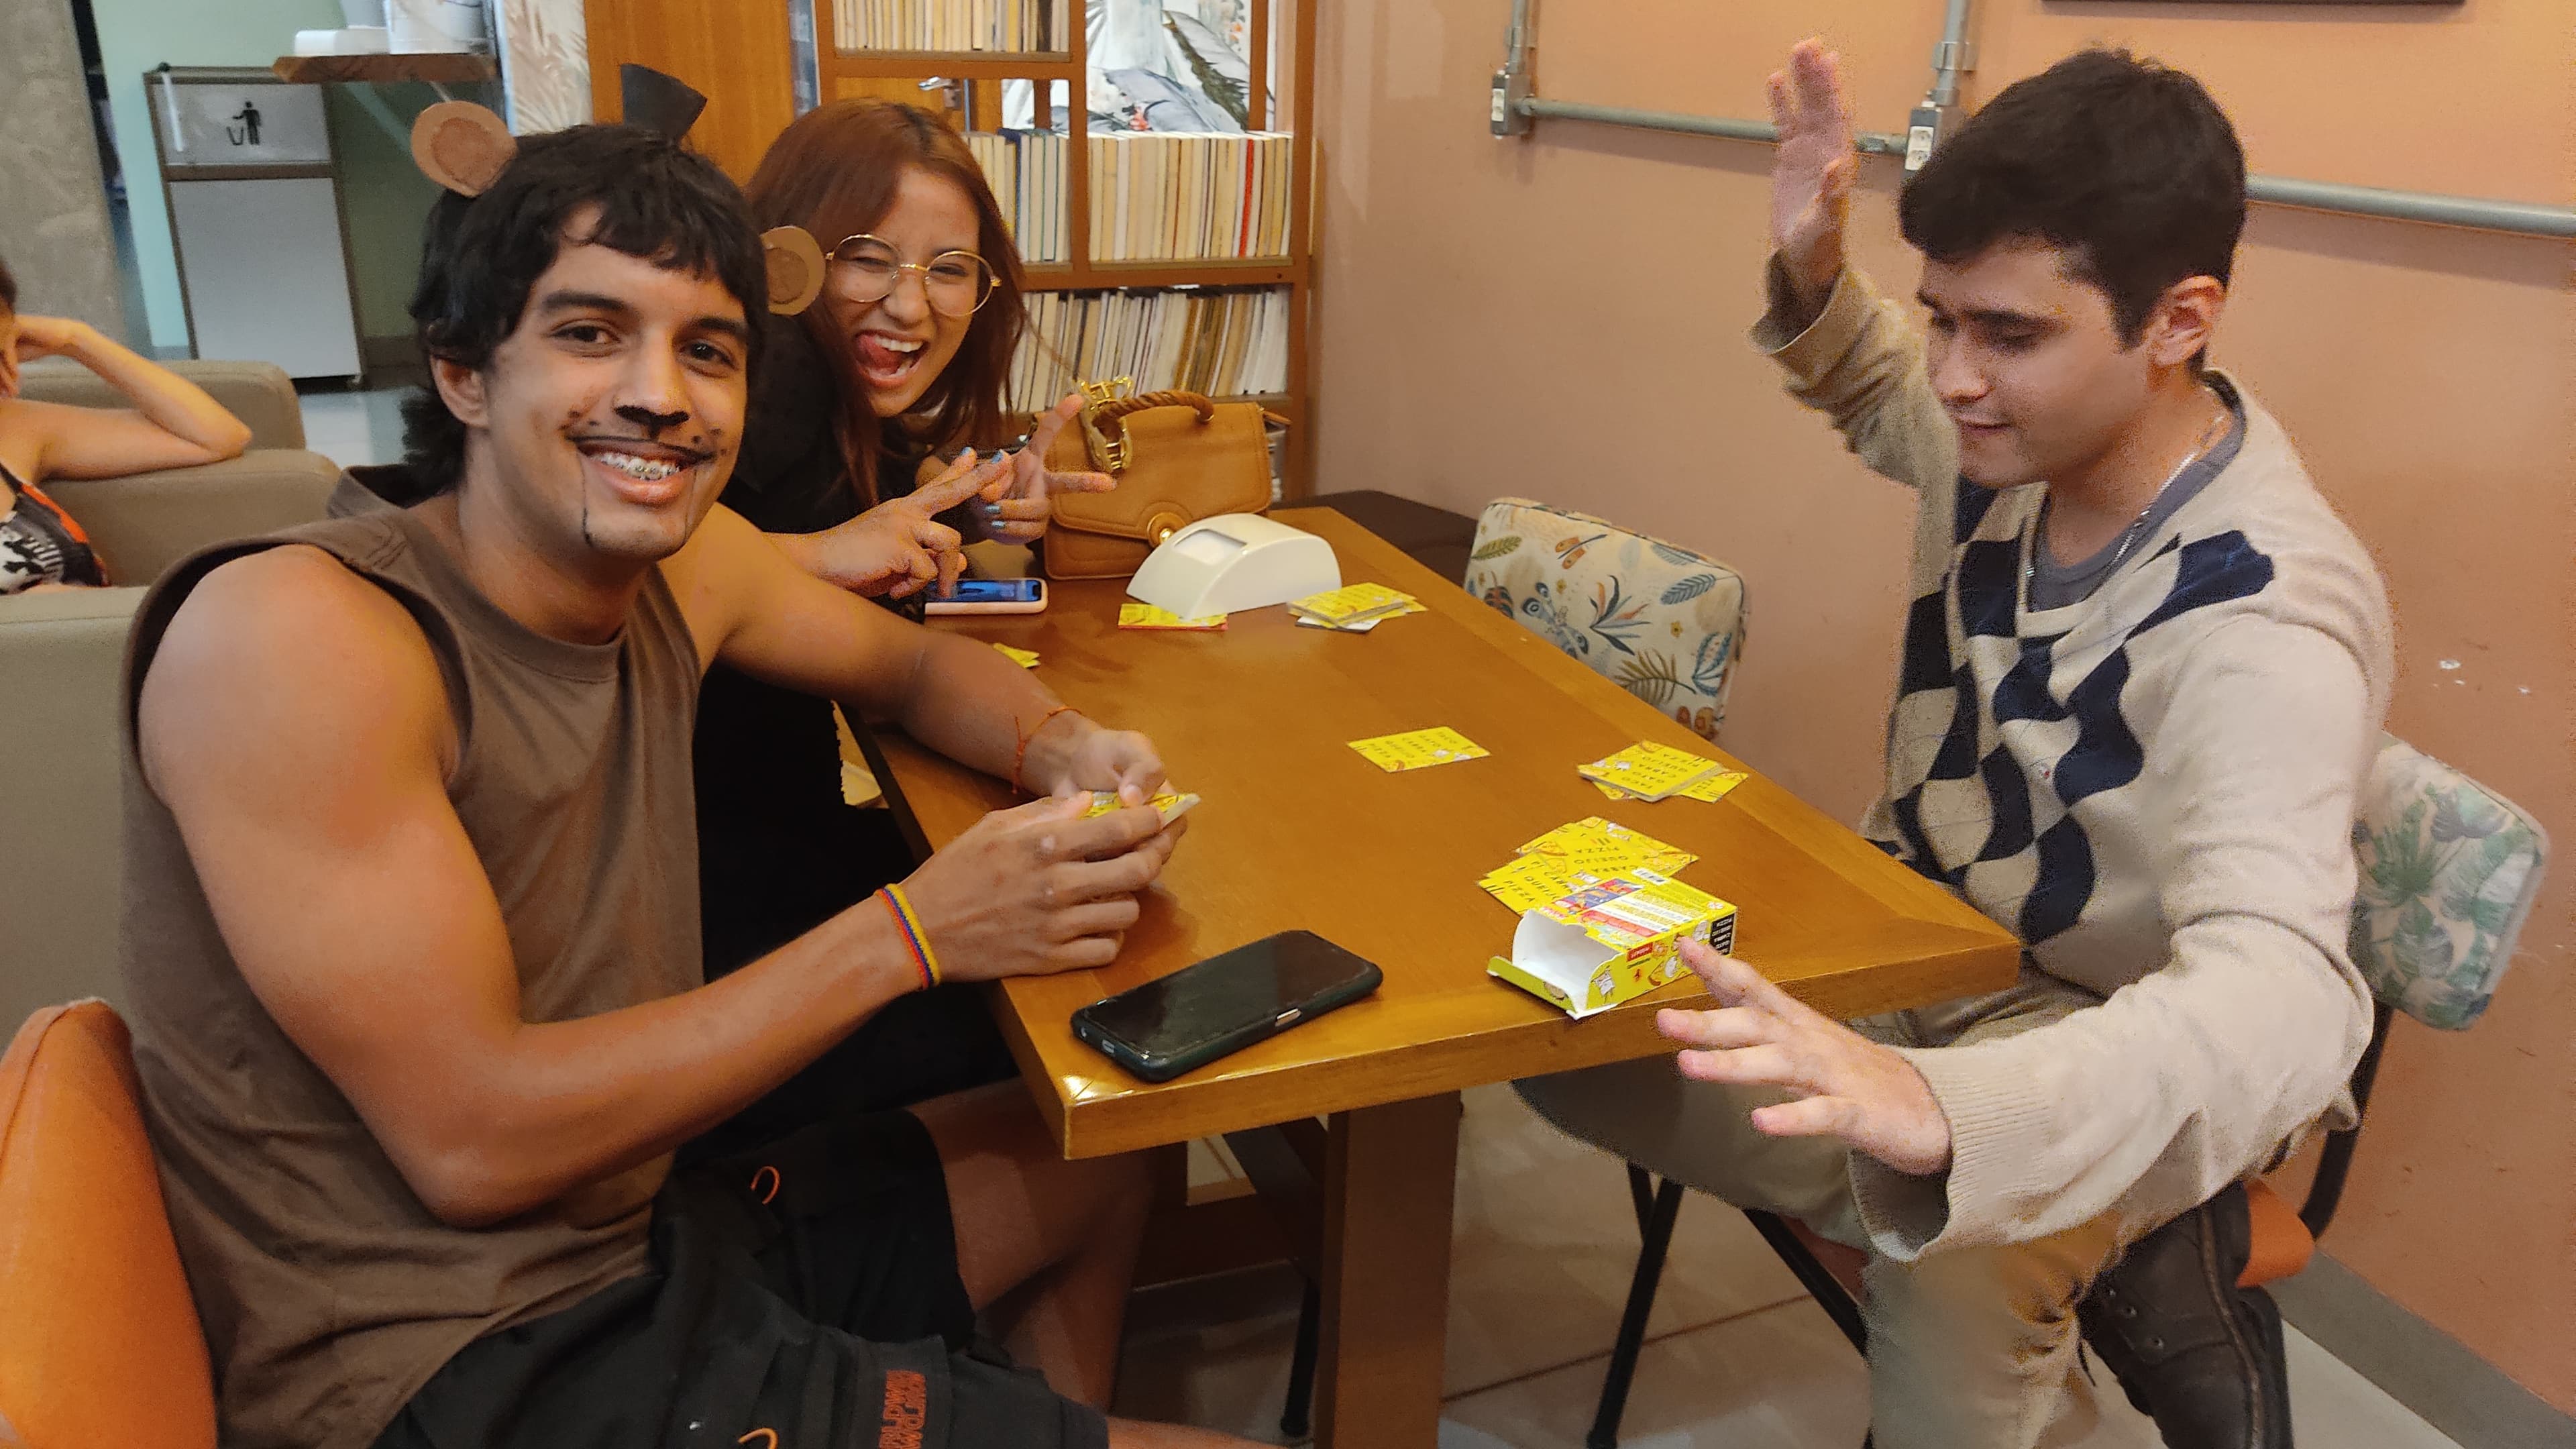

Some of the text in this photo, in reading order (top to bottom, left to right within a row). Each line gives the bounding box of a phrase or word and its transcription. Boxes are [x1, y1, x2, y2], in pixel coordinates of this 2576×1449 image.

[1642, 756, 1688, 772] QUEIJO
[1663, 753, 1700, 767] PIZZA
[1632, 771, 1665, 784] GATO
[1639, 763, 1676, 778] CABRA
[1621, 775, 1652, 790] TACO
[1573, 855, 1628, 864] QUEIJO
[1591, 864, 1638, 873] CABRA
[1502, 879, 1536, 902] PIZZA
